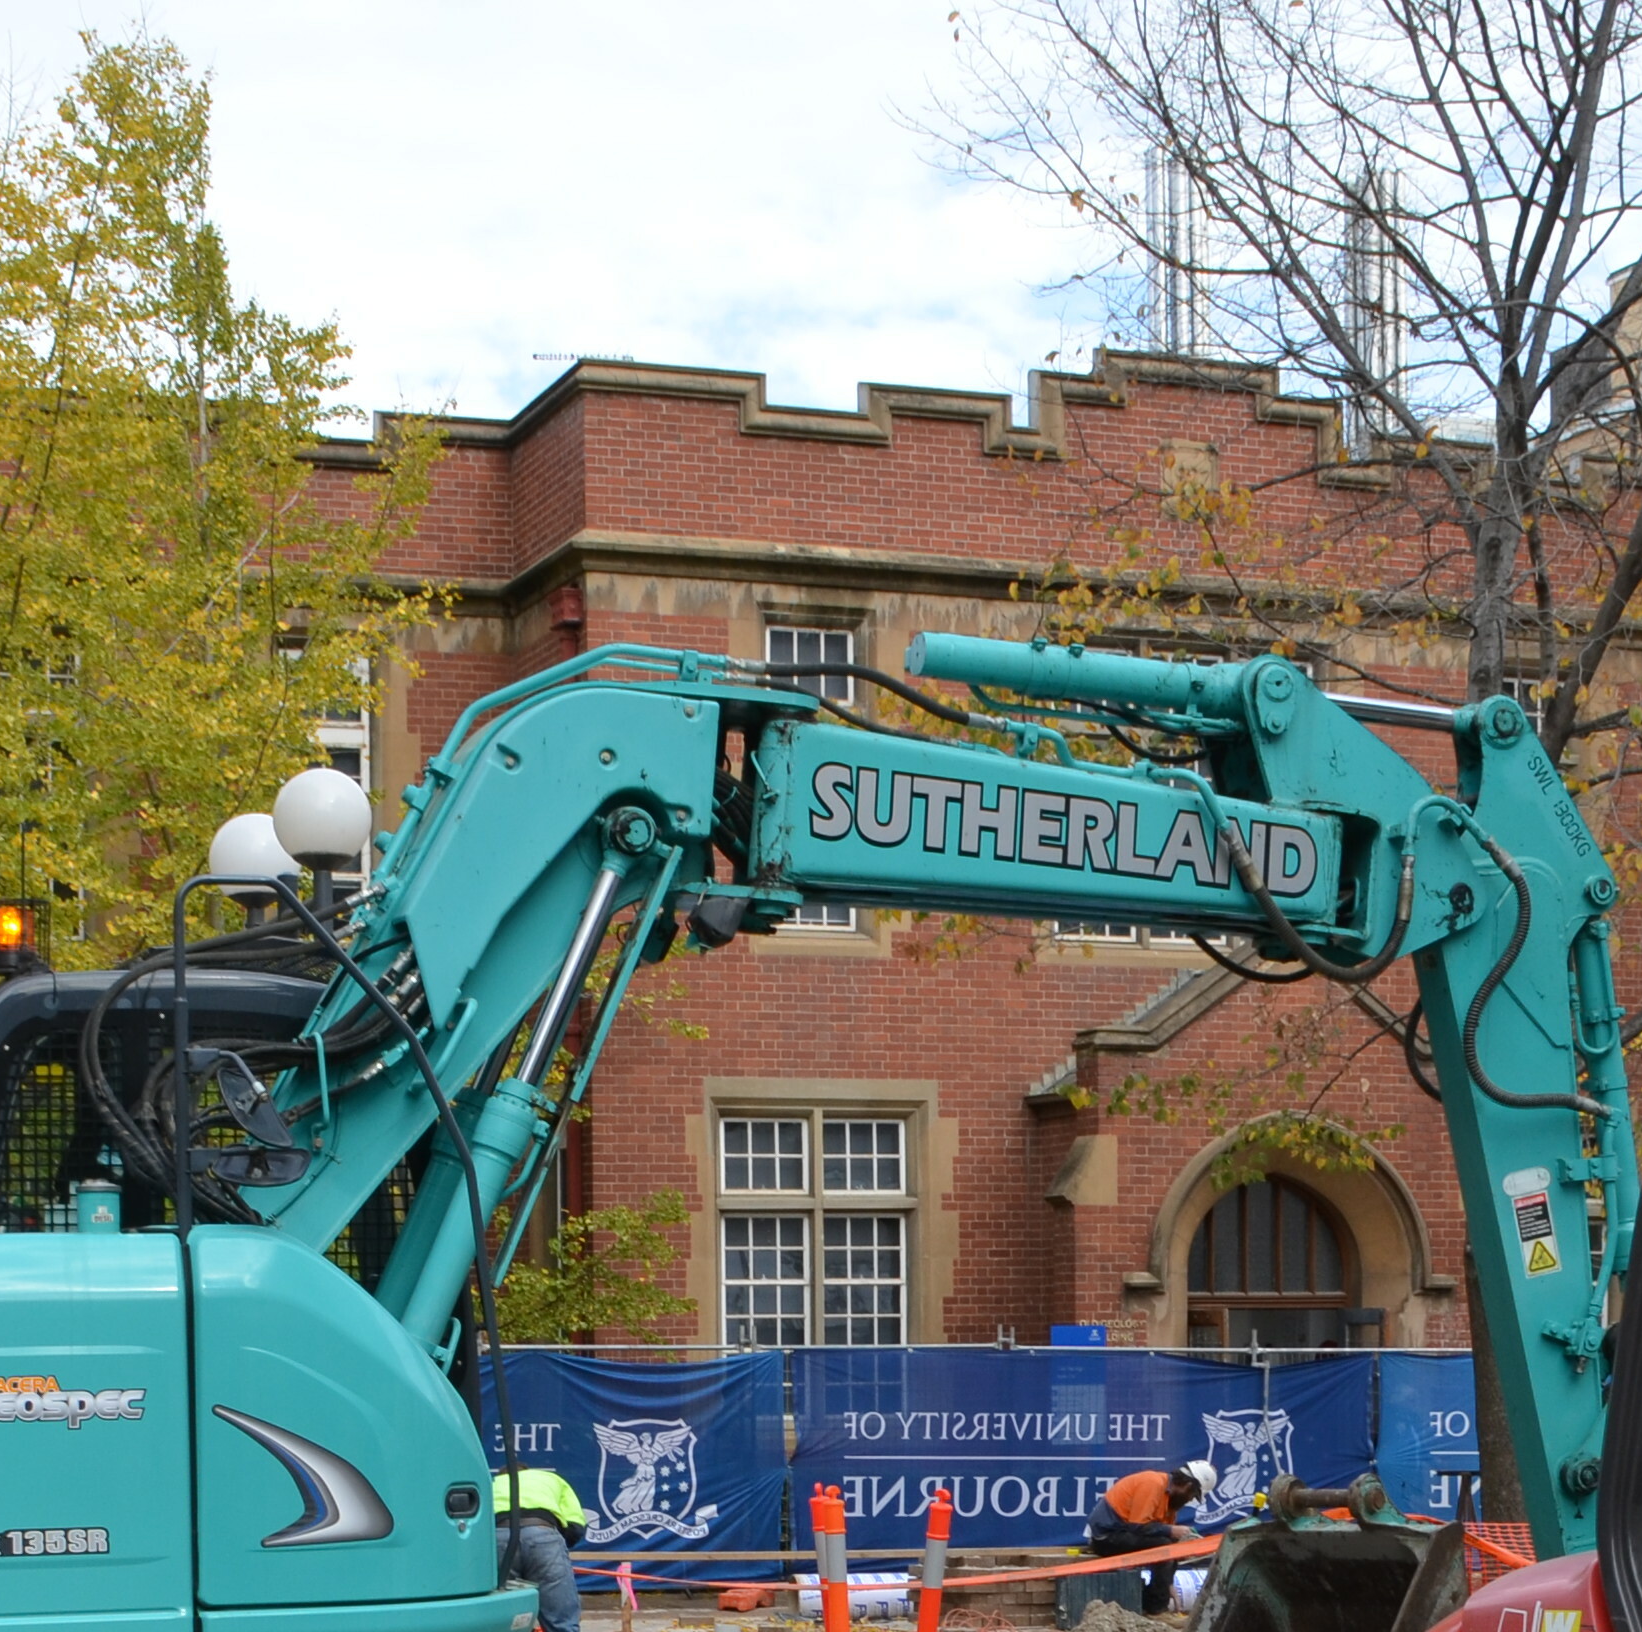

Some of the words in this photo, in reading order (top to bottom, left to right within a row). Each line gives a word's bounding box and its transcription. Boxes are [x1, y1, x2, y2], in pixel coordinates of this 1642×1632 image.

[1527, 756, 1554, 795] SWL
[809, 761, 1317, 897] SUTHERLAND
[6, 1528, 109, 1555] 135SR
